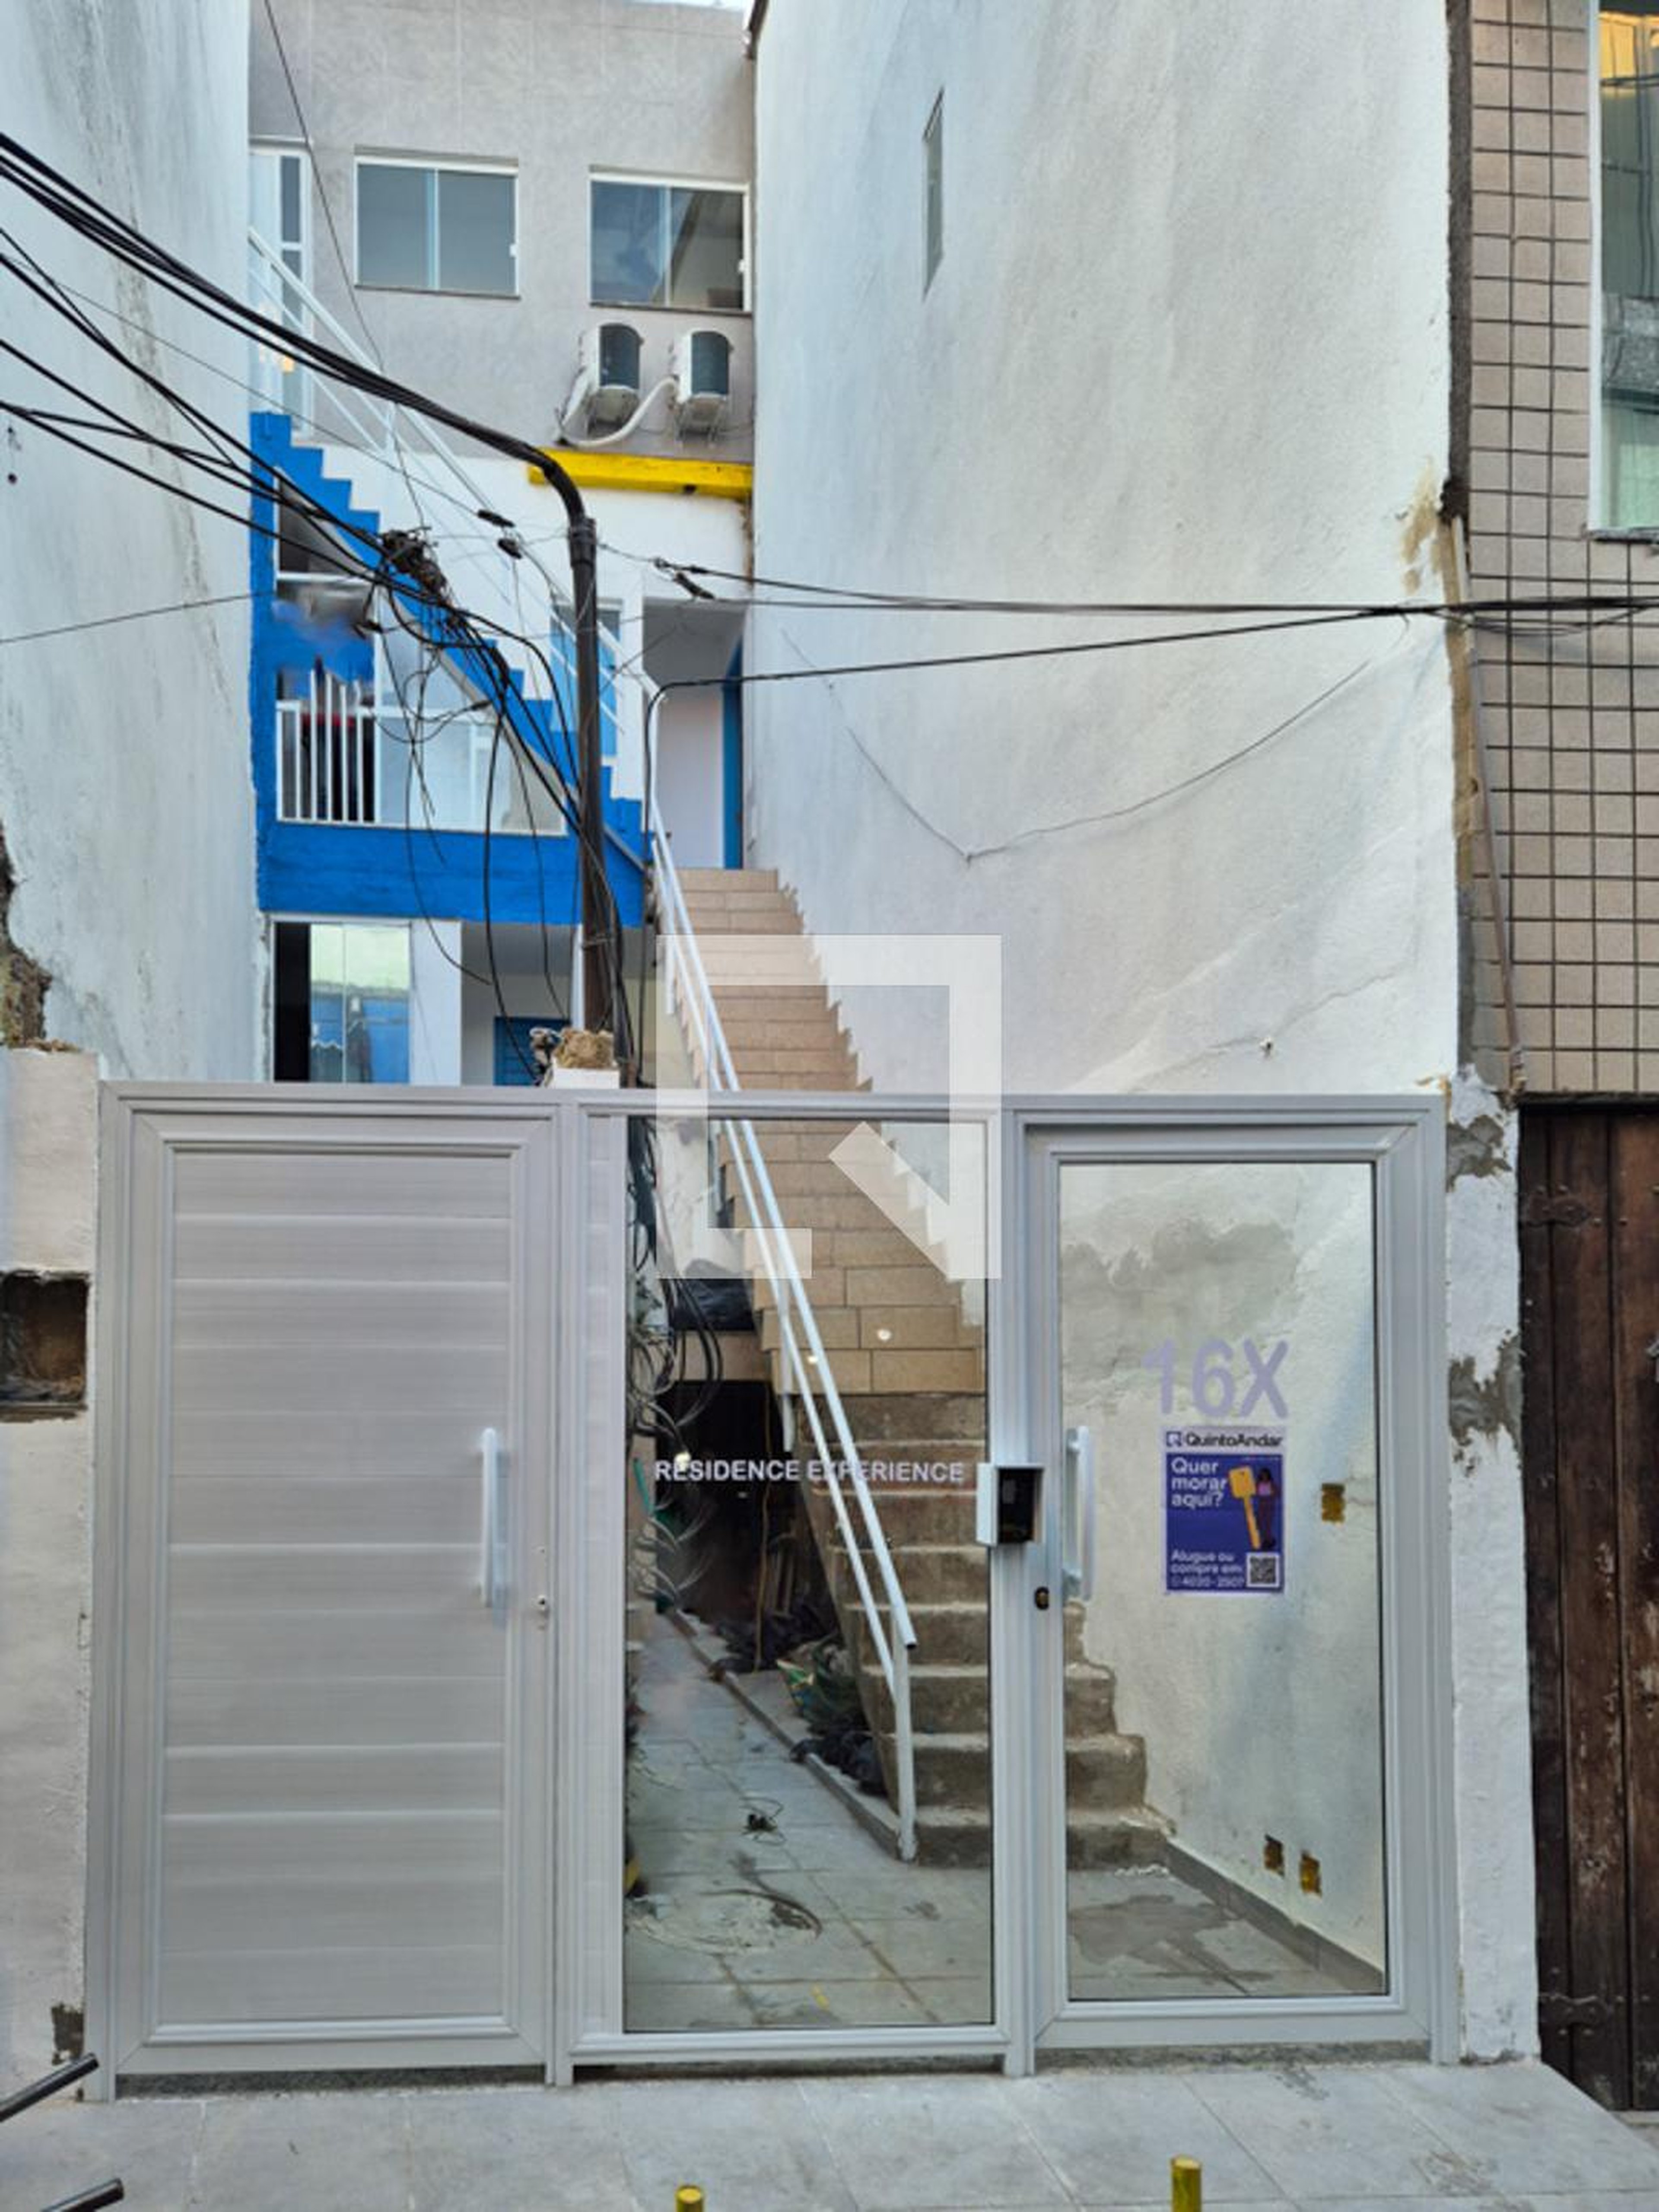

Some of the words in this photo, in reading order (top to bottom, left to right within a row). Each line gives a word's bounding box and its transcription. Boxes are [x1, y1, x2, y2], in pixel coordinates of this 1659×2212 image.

[1141, 1338, 1289, 1419] 16X
[1186, 1433, 1283, 1447] QuintoAndar
[655, 1460, 800, 1481] RESIDENCE
[1171, 1457, 1219, 1475] Quer
[1171, 1477, 1227, 1490] morar
[1171, 1492, 1224, 1510] aqui?
